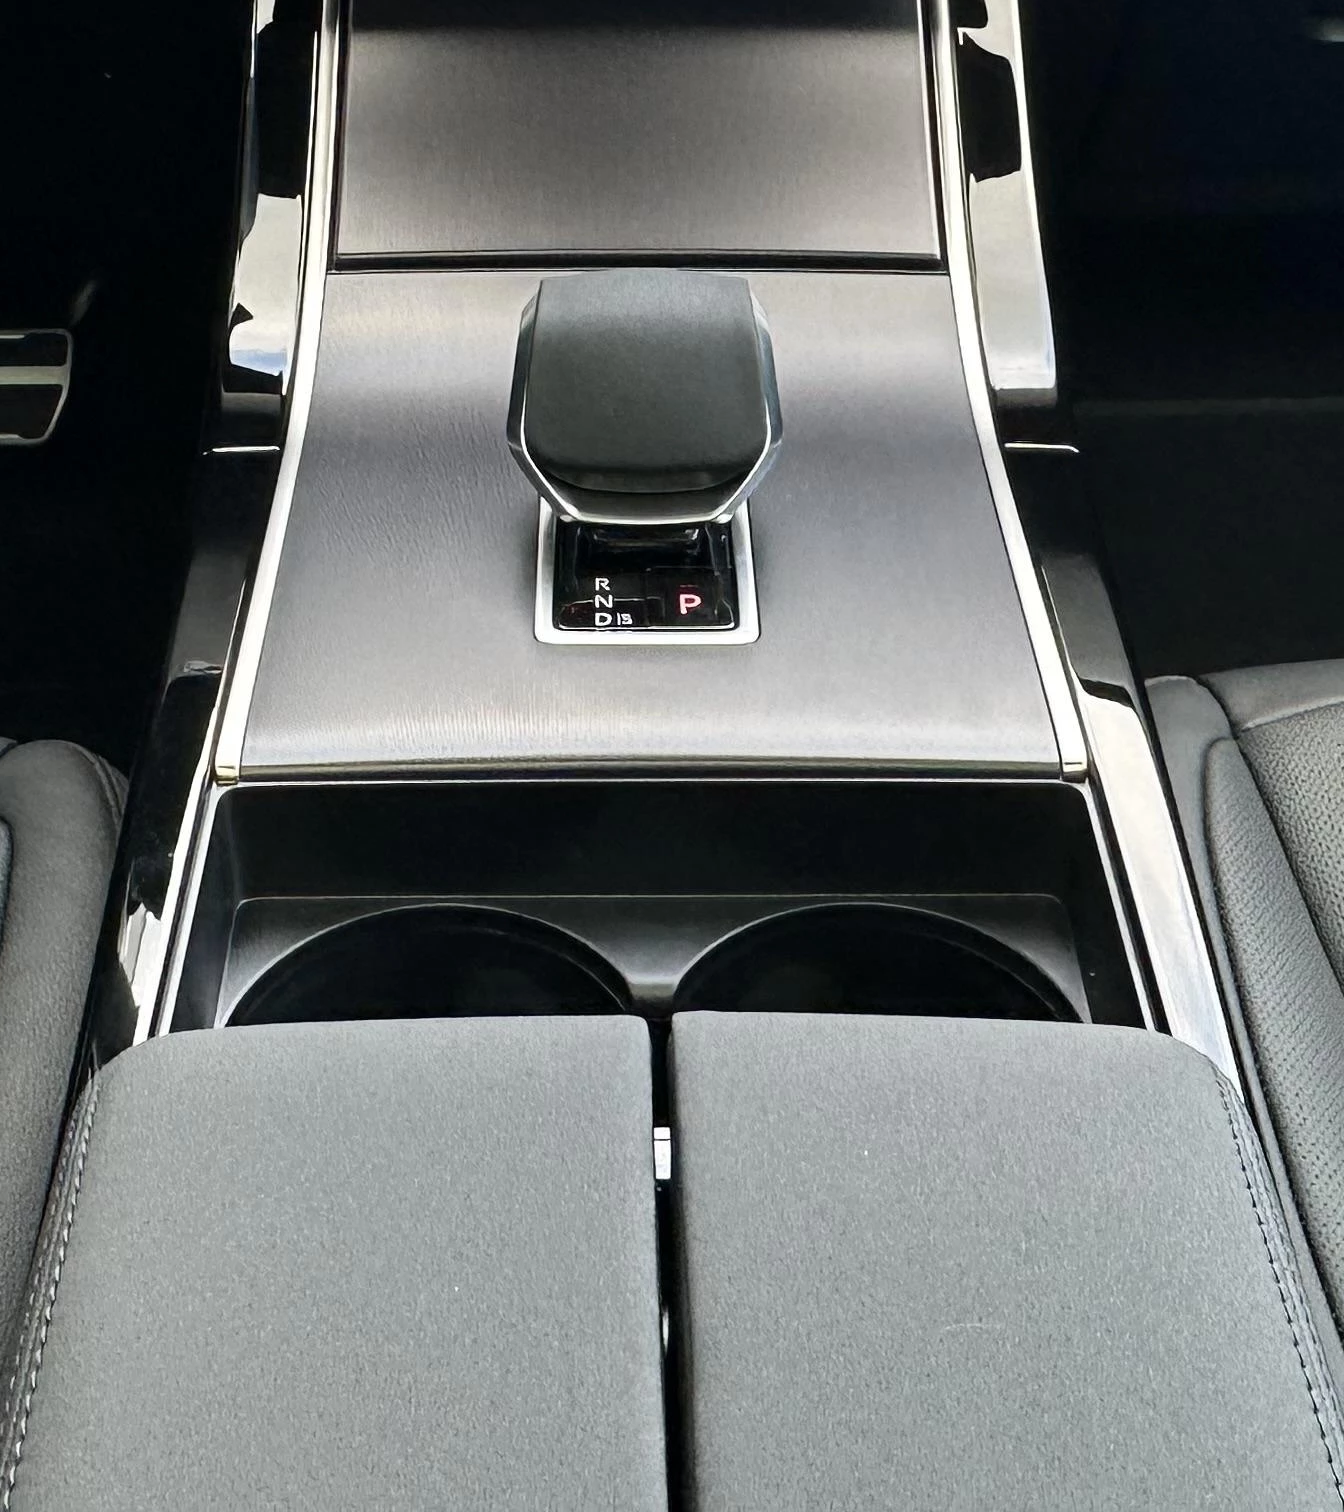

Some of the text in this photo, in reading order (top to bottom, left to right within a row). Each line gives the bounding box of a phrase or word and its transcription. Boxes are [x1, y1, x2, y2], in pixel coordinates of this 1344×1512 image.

[595, 576, 611, 591] R
[594, 594, 613, 609] N
[679, 593, 702, 615] P
[594, 612, 613, 627] D
